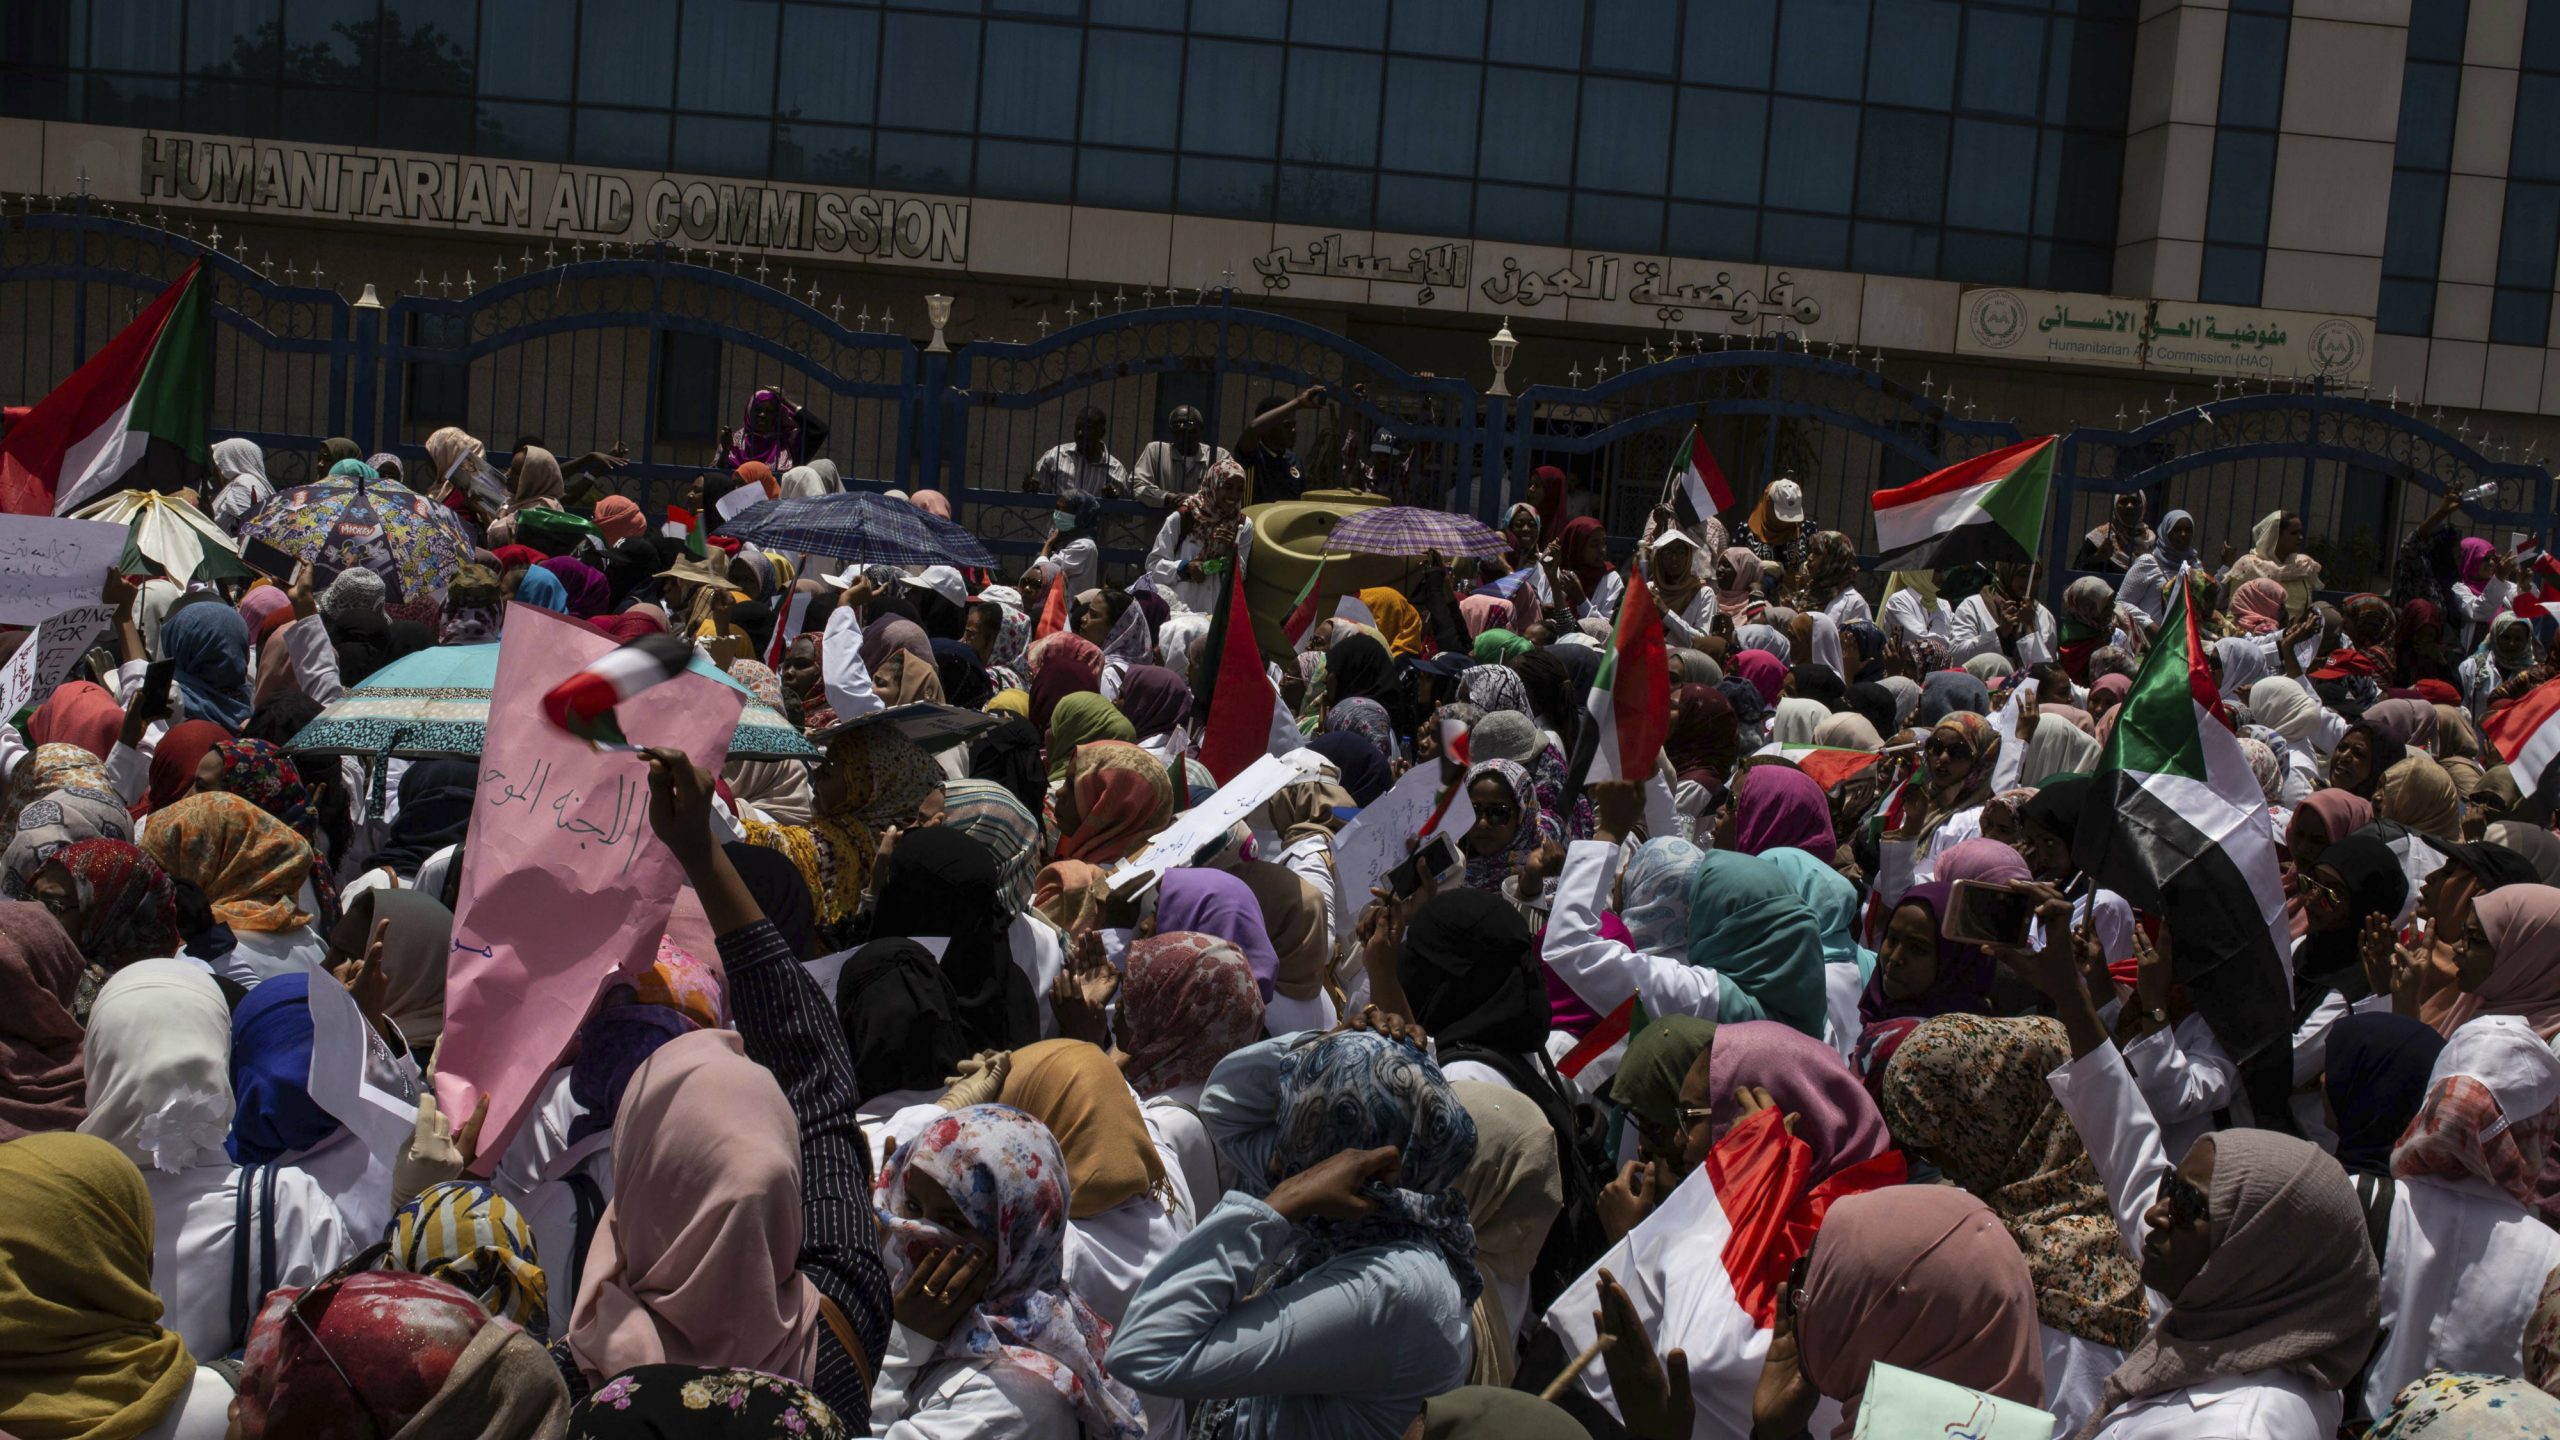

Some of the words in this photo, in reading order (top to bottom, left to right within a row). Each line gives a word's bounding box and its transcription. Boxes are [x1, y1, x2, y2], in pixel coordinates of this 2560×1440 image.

[140, 136, 532, 228] HUMANITARIAN
[543, 171, 634, 235] AID
[645, 178, 970, 264] COMMISSION
[1253, 233, 1469, 306] الإنساني
[1481, 253, 1620, 306] العون
[1630, 260, 1821, 325] مفوضية
[2205, 315, 2287, 351] مفوضية
[2048, 338, 2130, 356] Humanitarian
[2134, 342, 2153, 358] Ad
[2157, 346, 2232, 365] Commission
[2235, 352, 2273, 370] (HAC)
[43, 607, 115, 629] TANDING
[48, 625, 87, 643] FOR
[37, 647, 75, 668] AFE
